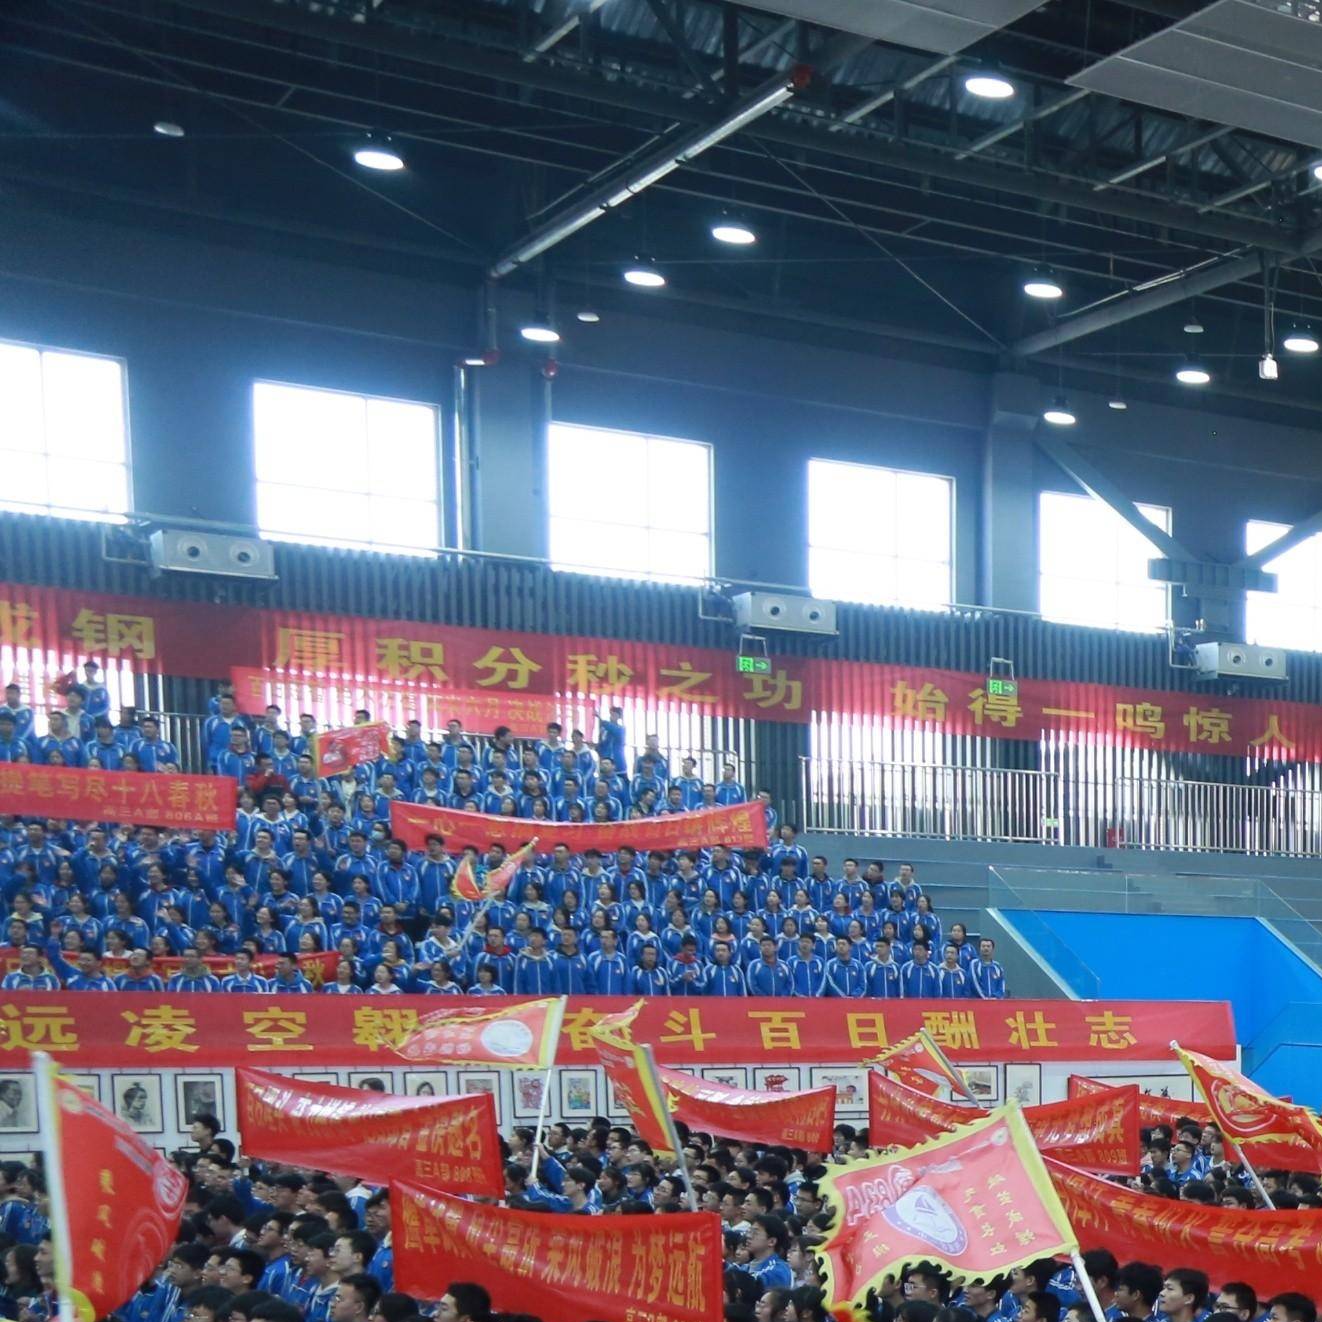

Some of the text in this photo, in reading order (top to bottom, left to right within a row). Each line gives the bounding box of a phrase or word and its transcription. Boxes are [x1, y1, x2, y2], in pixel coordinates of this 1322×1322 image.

[273, 627, 802, 710] 厚积分秒之功
[889, 680, 1295, 750] 始得一鸣惊人
